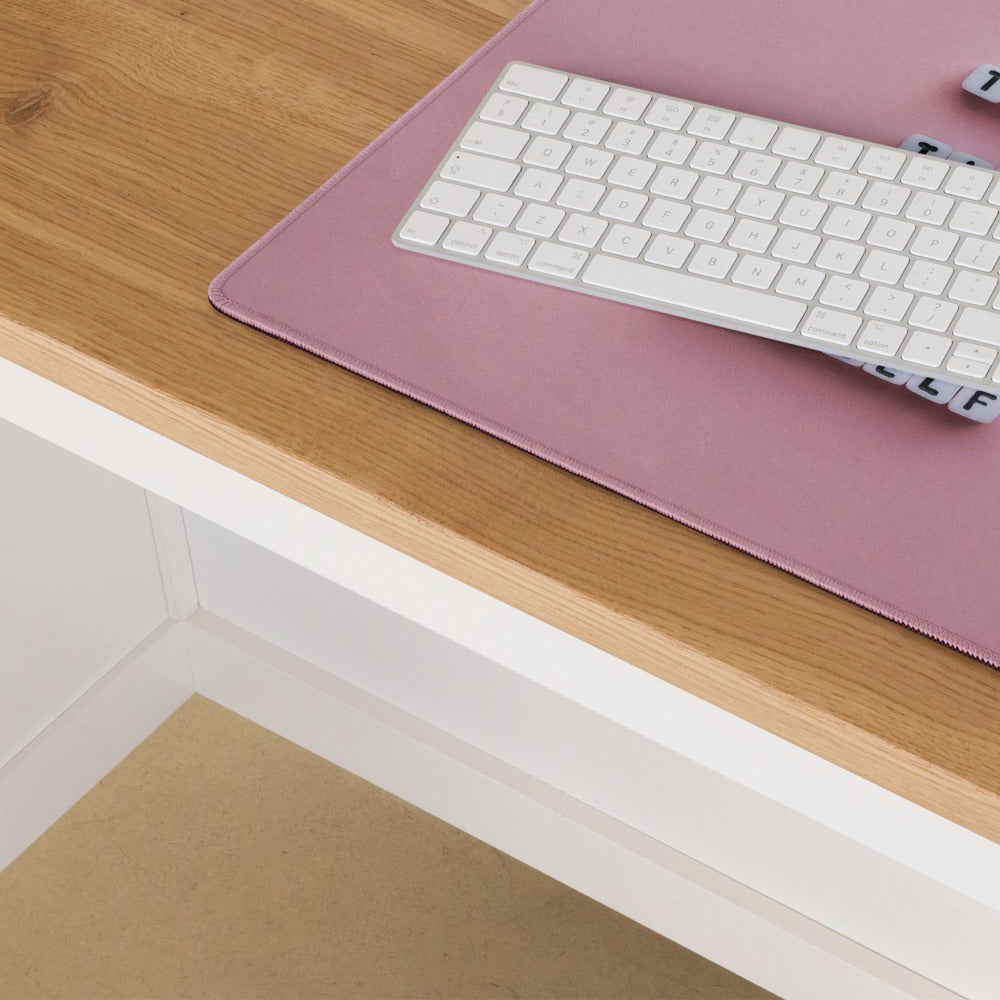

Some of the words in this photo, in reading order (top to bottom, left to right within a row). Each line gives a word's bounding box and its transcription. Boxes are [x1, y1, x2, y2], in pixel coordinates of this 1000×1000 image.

[543, 148, 553, 157] Q
[584, 158, 597, 166] W
[627, 168, 637, 176] E
[670, 178, 680, 186] R
[714, 188, 723, 196] T
[758, 198, 766, 206] Y
[799, 208, 810, 217] U
[886, 229, 896, 238] O
[580, 128, 590, 137] 2
[622, 138, 631, 147] 3
[707, 158, 716, 166] 5
[750, 168, 759, 176] 6
[836, 188, 845, 196] 8
[879, 198, 888, 206] 9
[533, 180, 542, 189] A
[618, 200, 629, 209] D
[705, 221, 715, 230] G
[748, 231, 759, 240] H
[836, 252, 845, 260] K
[880, 263, 887, 271] L
[535, 216, 546, 225] Z
[578, 225, 588, 234] X
[621, 236, 632, 245] C
[666, 246, 675, 255] V
[708, 257, 718, 266] B
[752, 268, 762, 276] N
[794, 277, 807, 286] M
[451, 240, 478, 249] control
[495, 251, 520, 260] option
[536, 260, 574, 273] command
[808, 326, 846, 339] command
[864, 339, 888, 349] option
